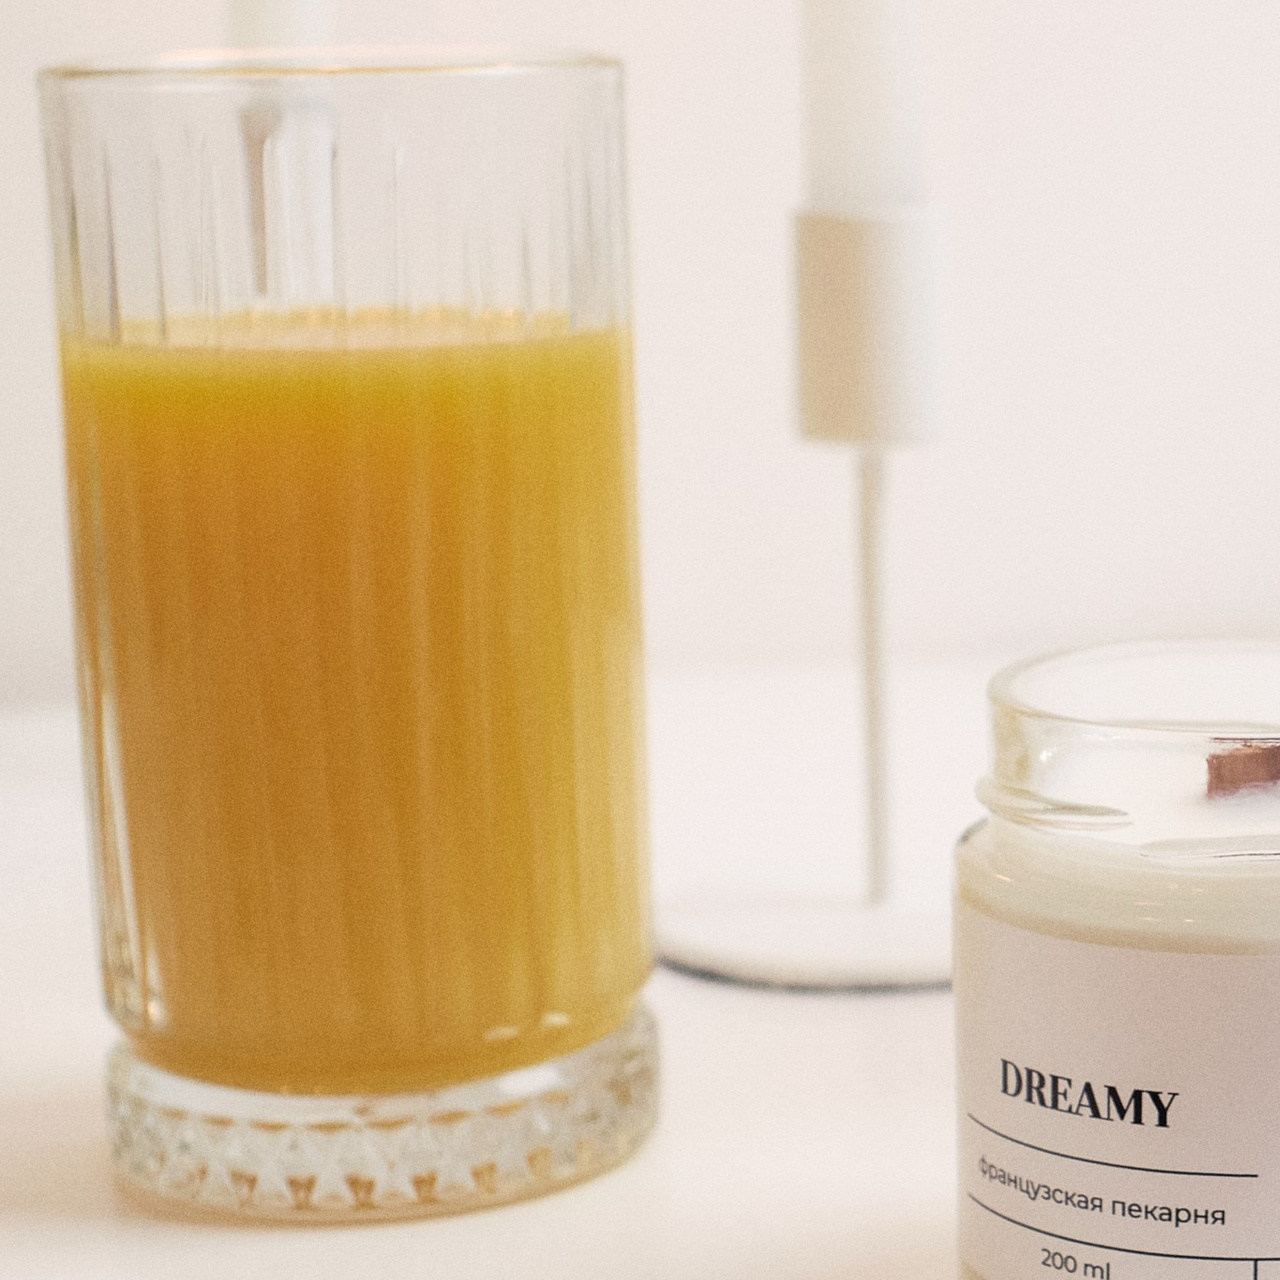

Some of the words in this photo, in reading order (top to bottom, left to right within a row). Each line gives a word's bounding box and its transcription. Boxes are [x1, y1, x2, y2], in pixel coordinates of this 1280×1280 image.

[1000, 1058, 1179, 1128] DREAMY
[979, 1156, 1103, 1212] французская
[1111, 1200, 1226, 1227] пекарня
[1041, 1248, 1077, 1273] 200
[1083, 1263, 1111, 1280] ml
